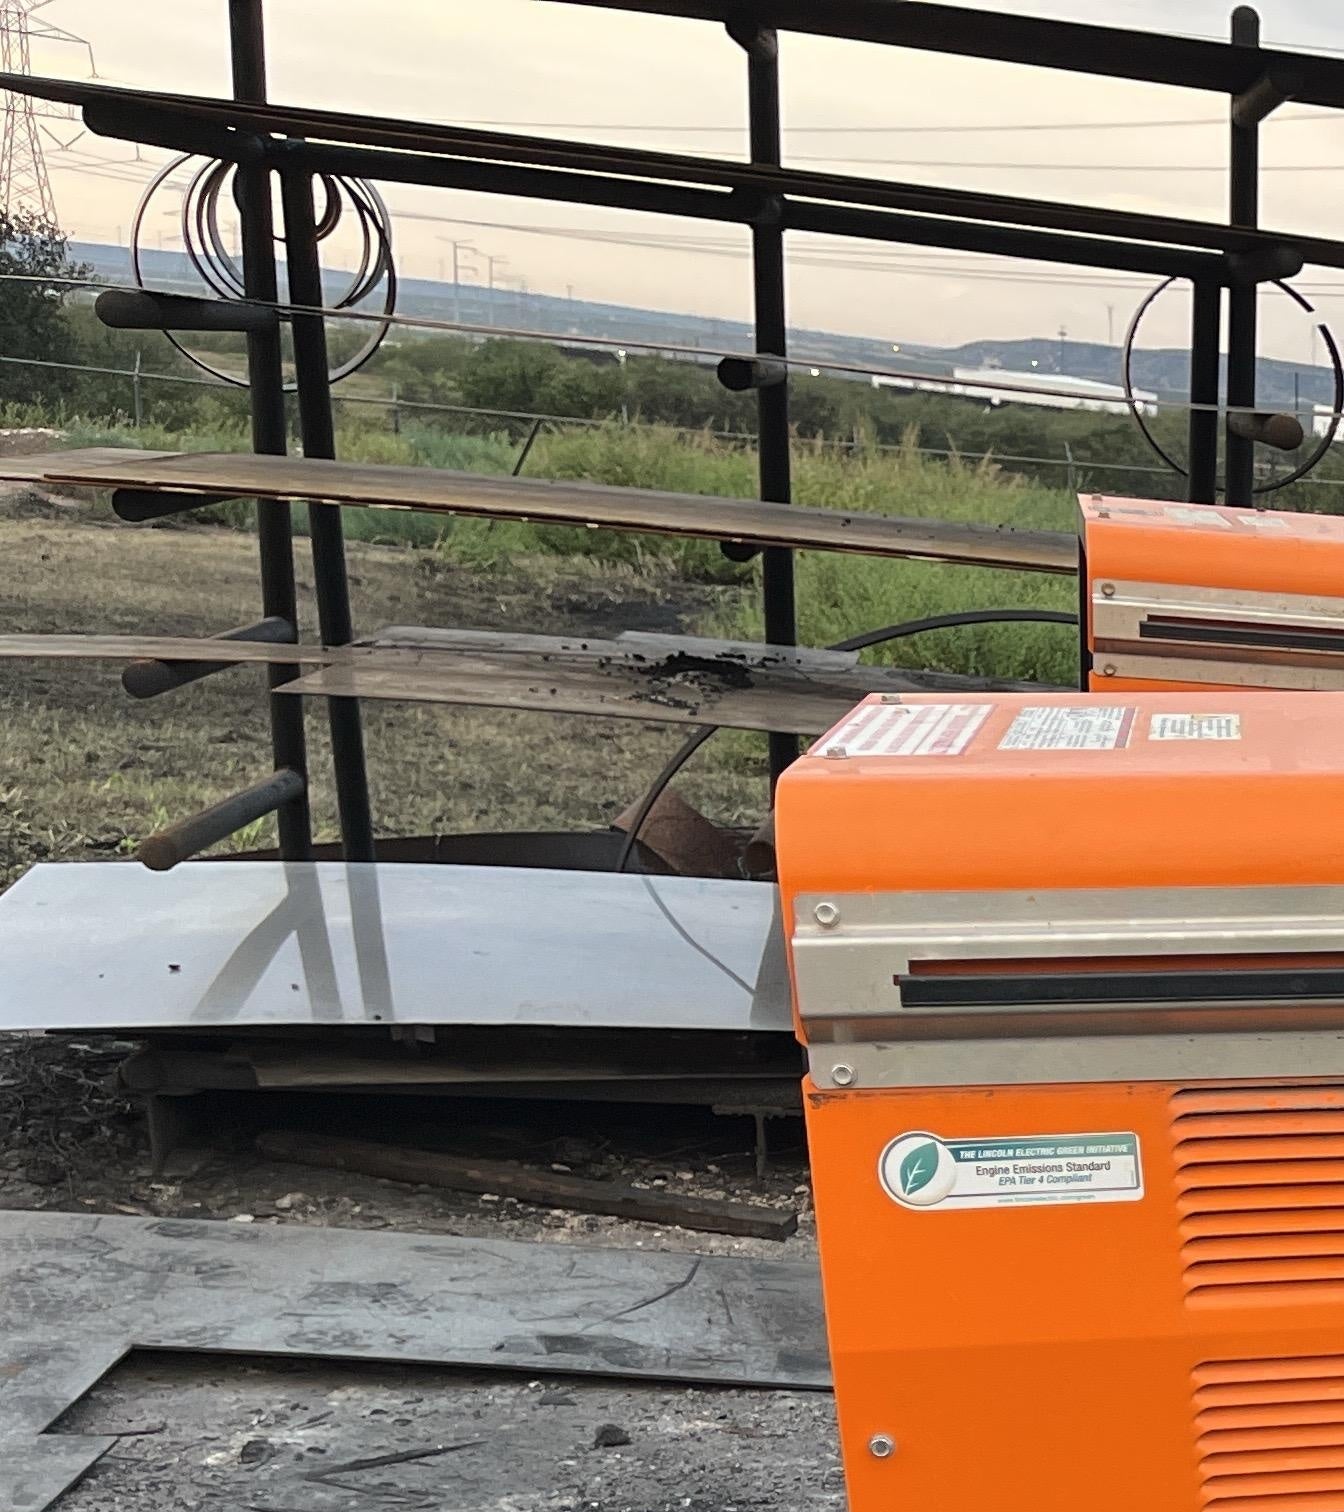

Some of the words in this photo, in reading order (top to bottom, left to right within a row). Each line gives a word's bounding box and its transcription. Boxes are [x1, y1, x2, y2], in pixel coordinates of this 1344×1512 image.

[978, 1148, 1013, 1158] LINCOLN
[1016, 1147, 1055, 1157] ELECTRIC
[976, 1165, 1010, 1177] Engine
[1013, 1163, 1064, 1175] Emissions
[1066, 1161, 1111, 1172] Standard
[998, 1176, 1016, 1186] EPA
[1018, 1175, 1036, 1185] Tier
[1046, 1173, 1092, 1185] Compliant
